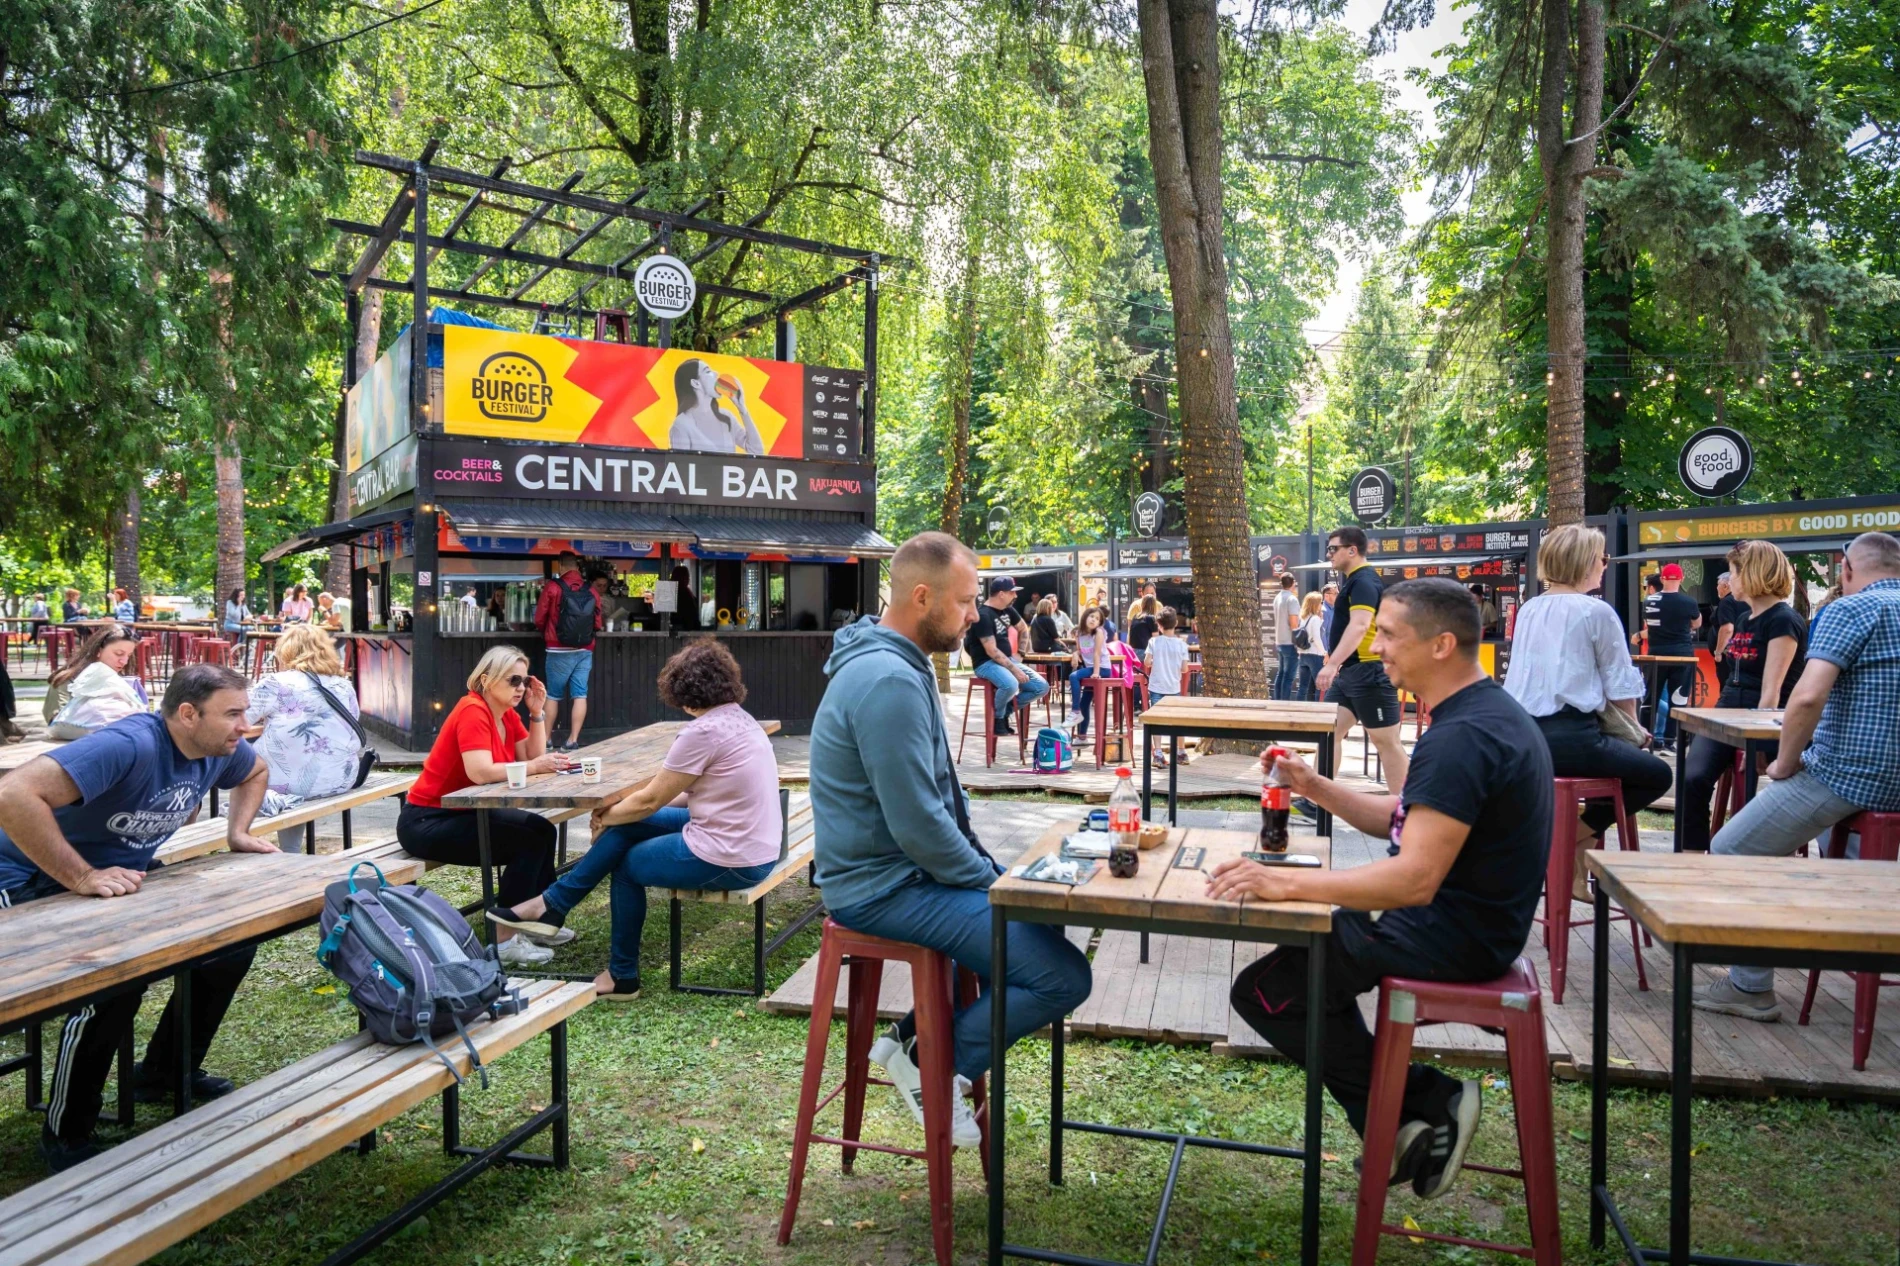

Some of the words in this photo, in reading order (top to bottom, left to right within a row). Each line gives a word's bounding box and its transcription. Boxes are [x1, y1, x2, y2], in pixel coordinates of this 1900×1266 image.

[639, 280, 692, 301] BURGER
[651, 296, 681, 307] FESTIVAL
[471, 377, 553, 406] BURGER
[490, 401, 536, 416] FESTIVAL
[461, 458, 503, 471] BEER&
[1694, 448, 1728, 467] good
[1701, 458, 1733, 475] food
[356, 464, 385, 507] CENTRAL
[385, 454, 400, 492] BAR
[433, 469, 504, 483] COCKTAILS
[515, 453, 708, 497] CENTRAL
[722, 465, 798, 501] BAR
[809, 477, 862, 495] RAKIJARNICA
[1360, 486, 1381, 497] BURGER
[1357, 495, 1384, 506] INSTITUTE
[1698, 519, 1769, 537] BURGERS
[1773, 518, 1795, 532] BY
[1799, 514, 1848, 531] GOOD
[1852, 511, 1900, 527] FOOD
[1485, 532, 1510, 543] BURGER
[1119, 548, 1136, 557] Chef's
[1485, 542, 1510, 550] INSTITUTE
[1119, 556, 1138, 565] Burger
[135, 812, 172, 821] WORLD
